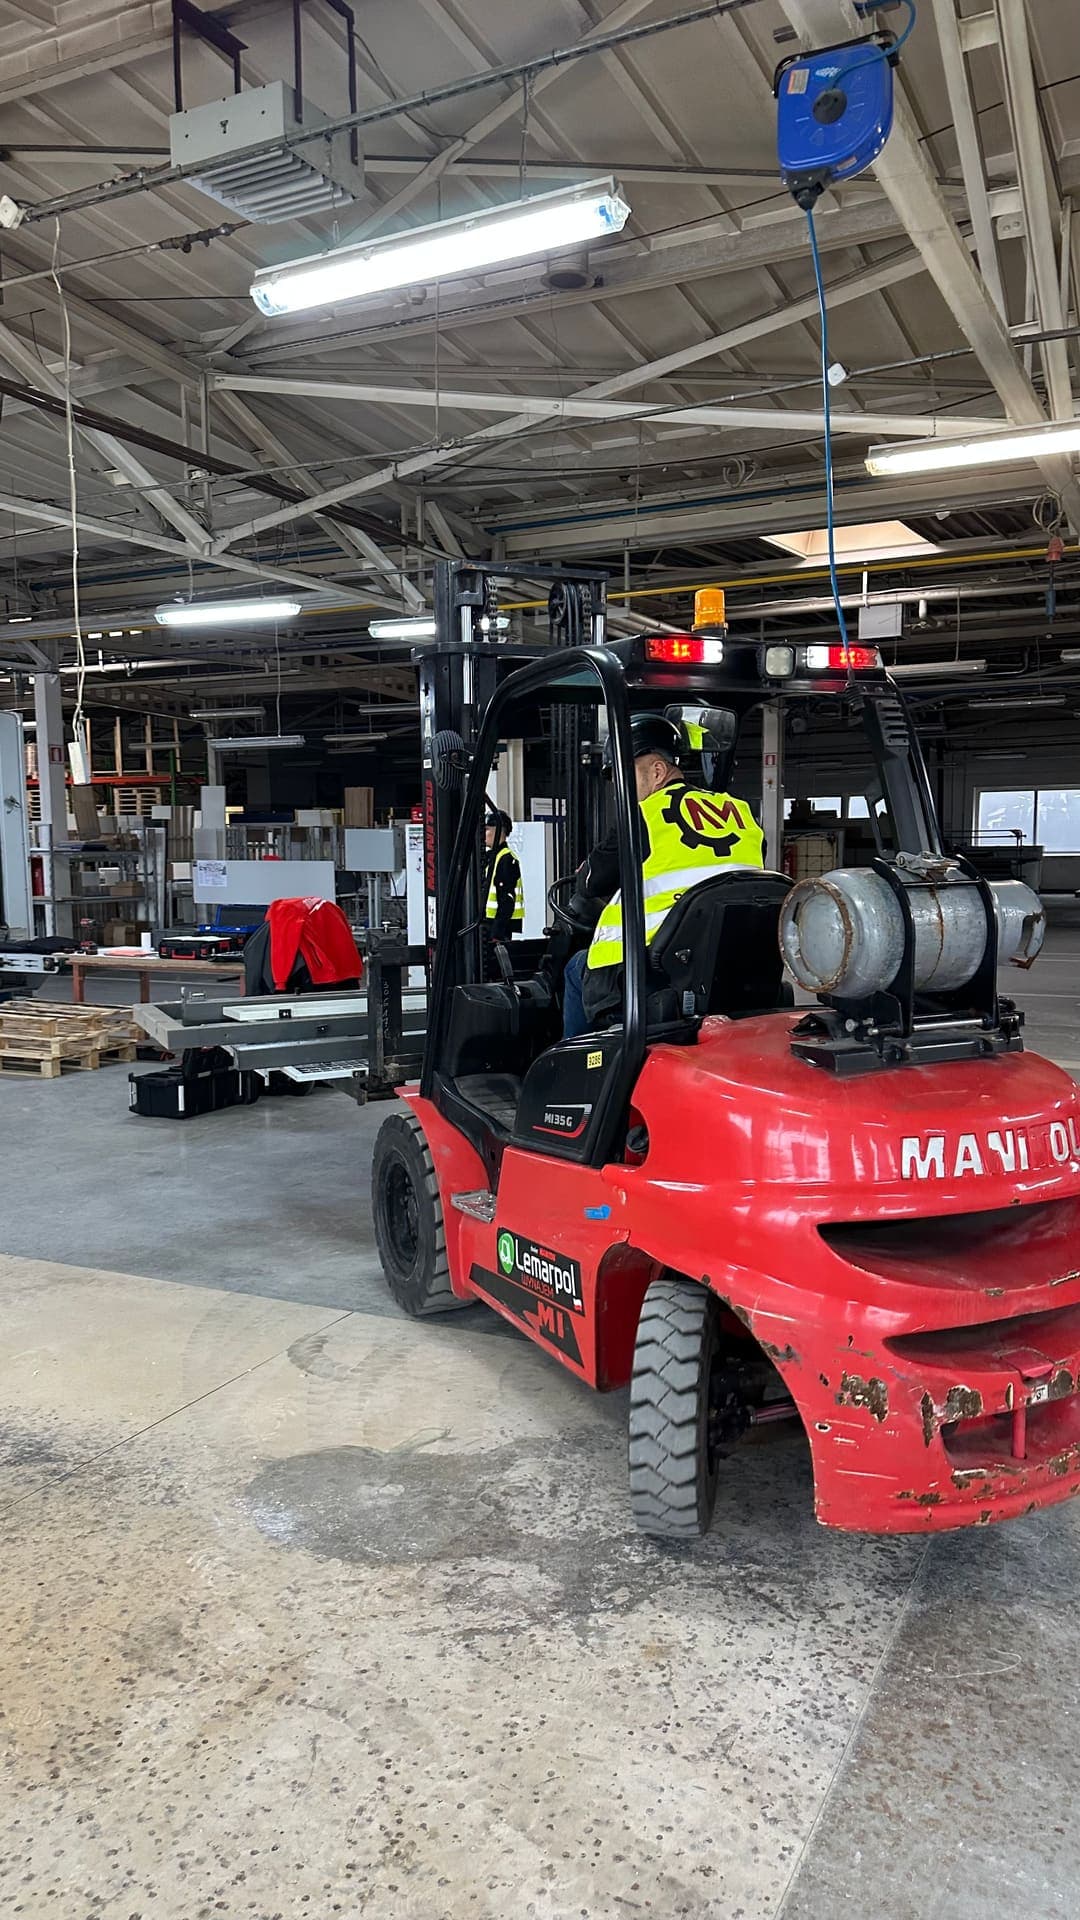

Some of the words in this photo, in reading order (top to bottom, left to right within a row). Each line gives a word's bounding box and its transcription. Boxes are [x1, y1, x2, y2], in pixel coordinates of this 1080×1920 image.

[425, 780, 435, 890] MANITOU
[901, 1116, 1080, 1179] MANIOU
[515, 1239, 576, 1297] Lemarpol
[537, 1301, 564, 1339] MI
